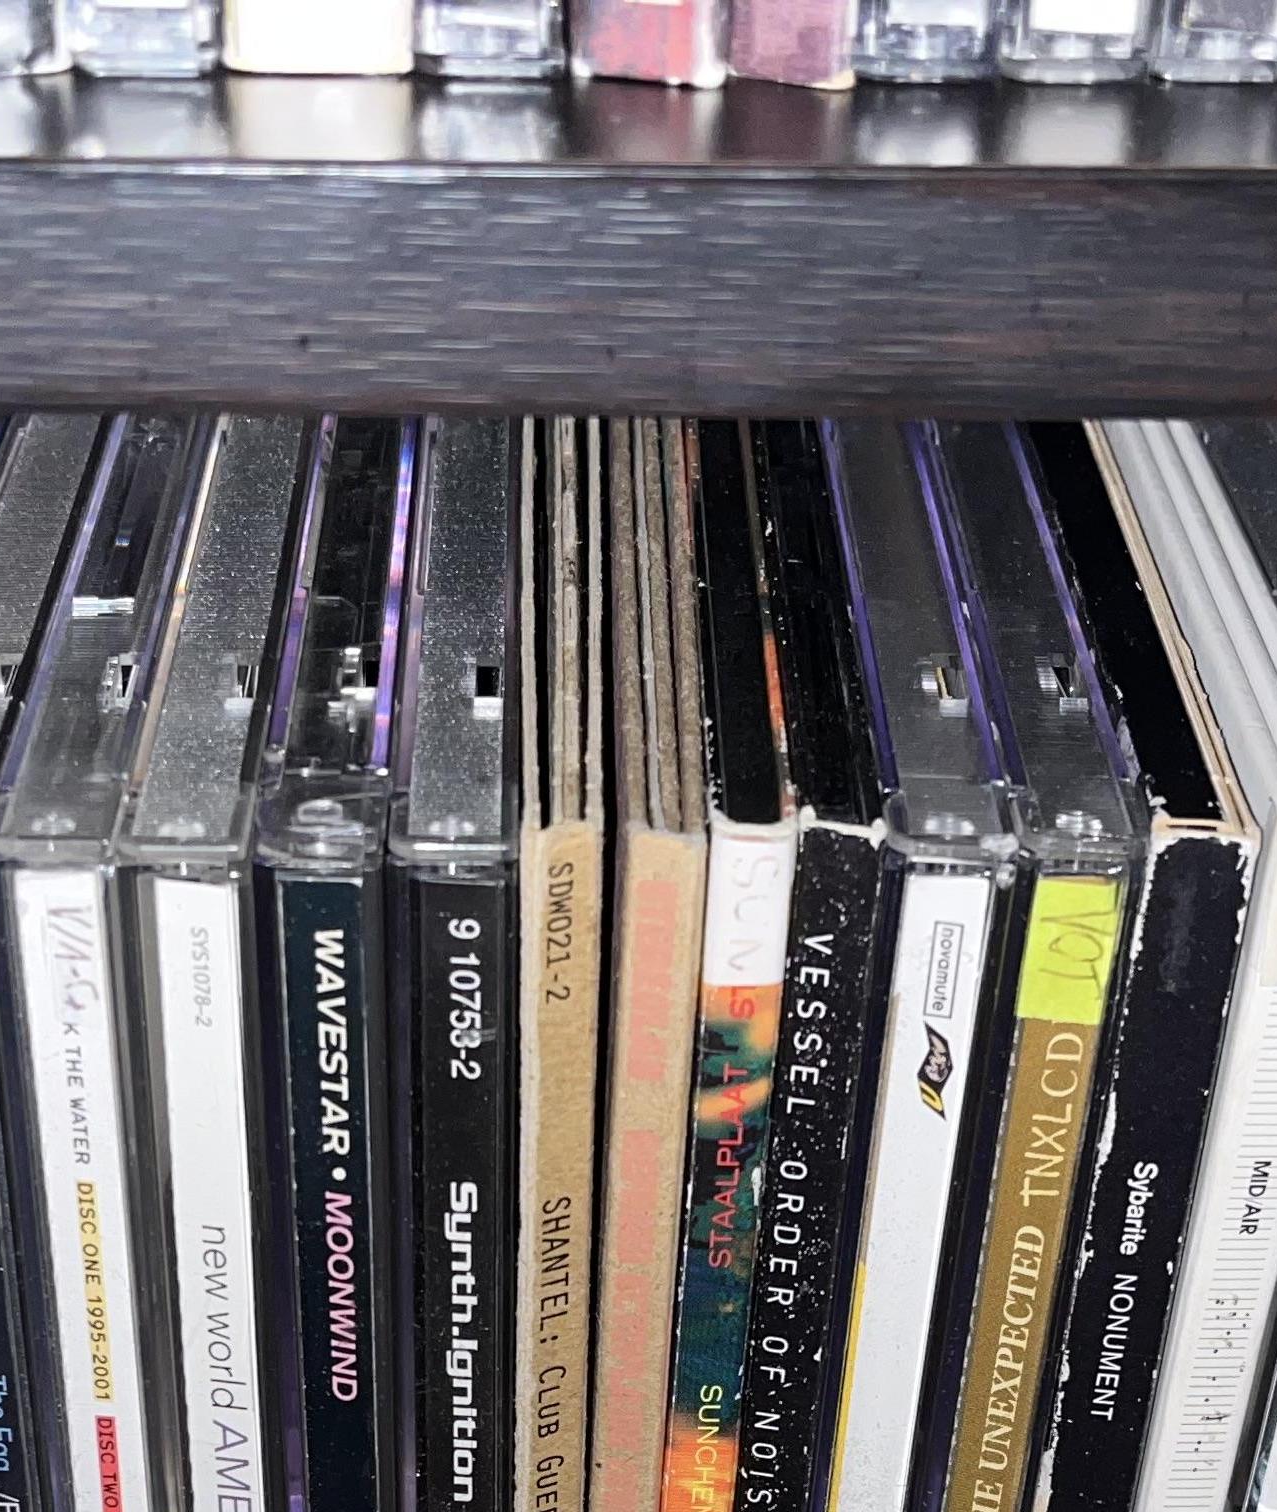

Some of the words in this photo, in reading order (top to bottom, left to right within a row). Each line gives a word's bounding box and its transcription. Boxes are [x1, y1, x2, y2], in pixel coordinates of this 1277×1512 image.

[926, 927, 955, 1016] novamute
[64, 1045, 85, 1089] THE
[313, 928, 351, 1156] WAVESTAR
[785, 933, 835, 1115] VESSEL
[69, 1097, 92, 1165] WATER
[708, 1062, 749, 1269] STAALPLAAT
[76, 1181, 98, 1235] DISC
[765, 1159, 809, 1306] ORDER
[1118, 1160, 1160, 1256] Sybarite
[81, 1242, 102, 1286] ONE
[201, 1224, 230, 1301] new
[324, 1190, 359, 1402] MOONWIND
[539, 1196, 572, 1345] SHANTEL:
[86, 1295, 111, 1400] 1995-2001
[205, 1311, 249, 1412] world
[443, 1181, 479, 1503] Synth.Ignition
[759, 1335, 790, 1384] OF
[977, 1225, 1046, 1471] UNEXPECTED
[1089, 1273, 1139, 1422] NONUMENT
[96, 1417, 117, 1465] DISC
